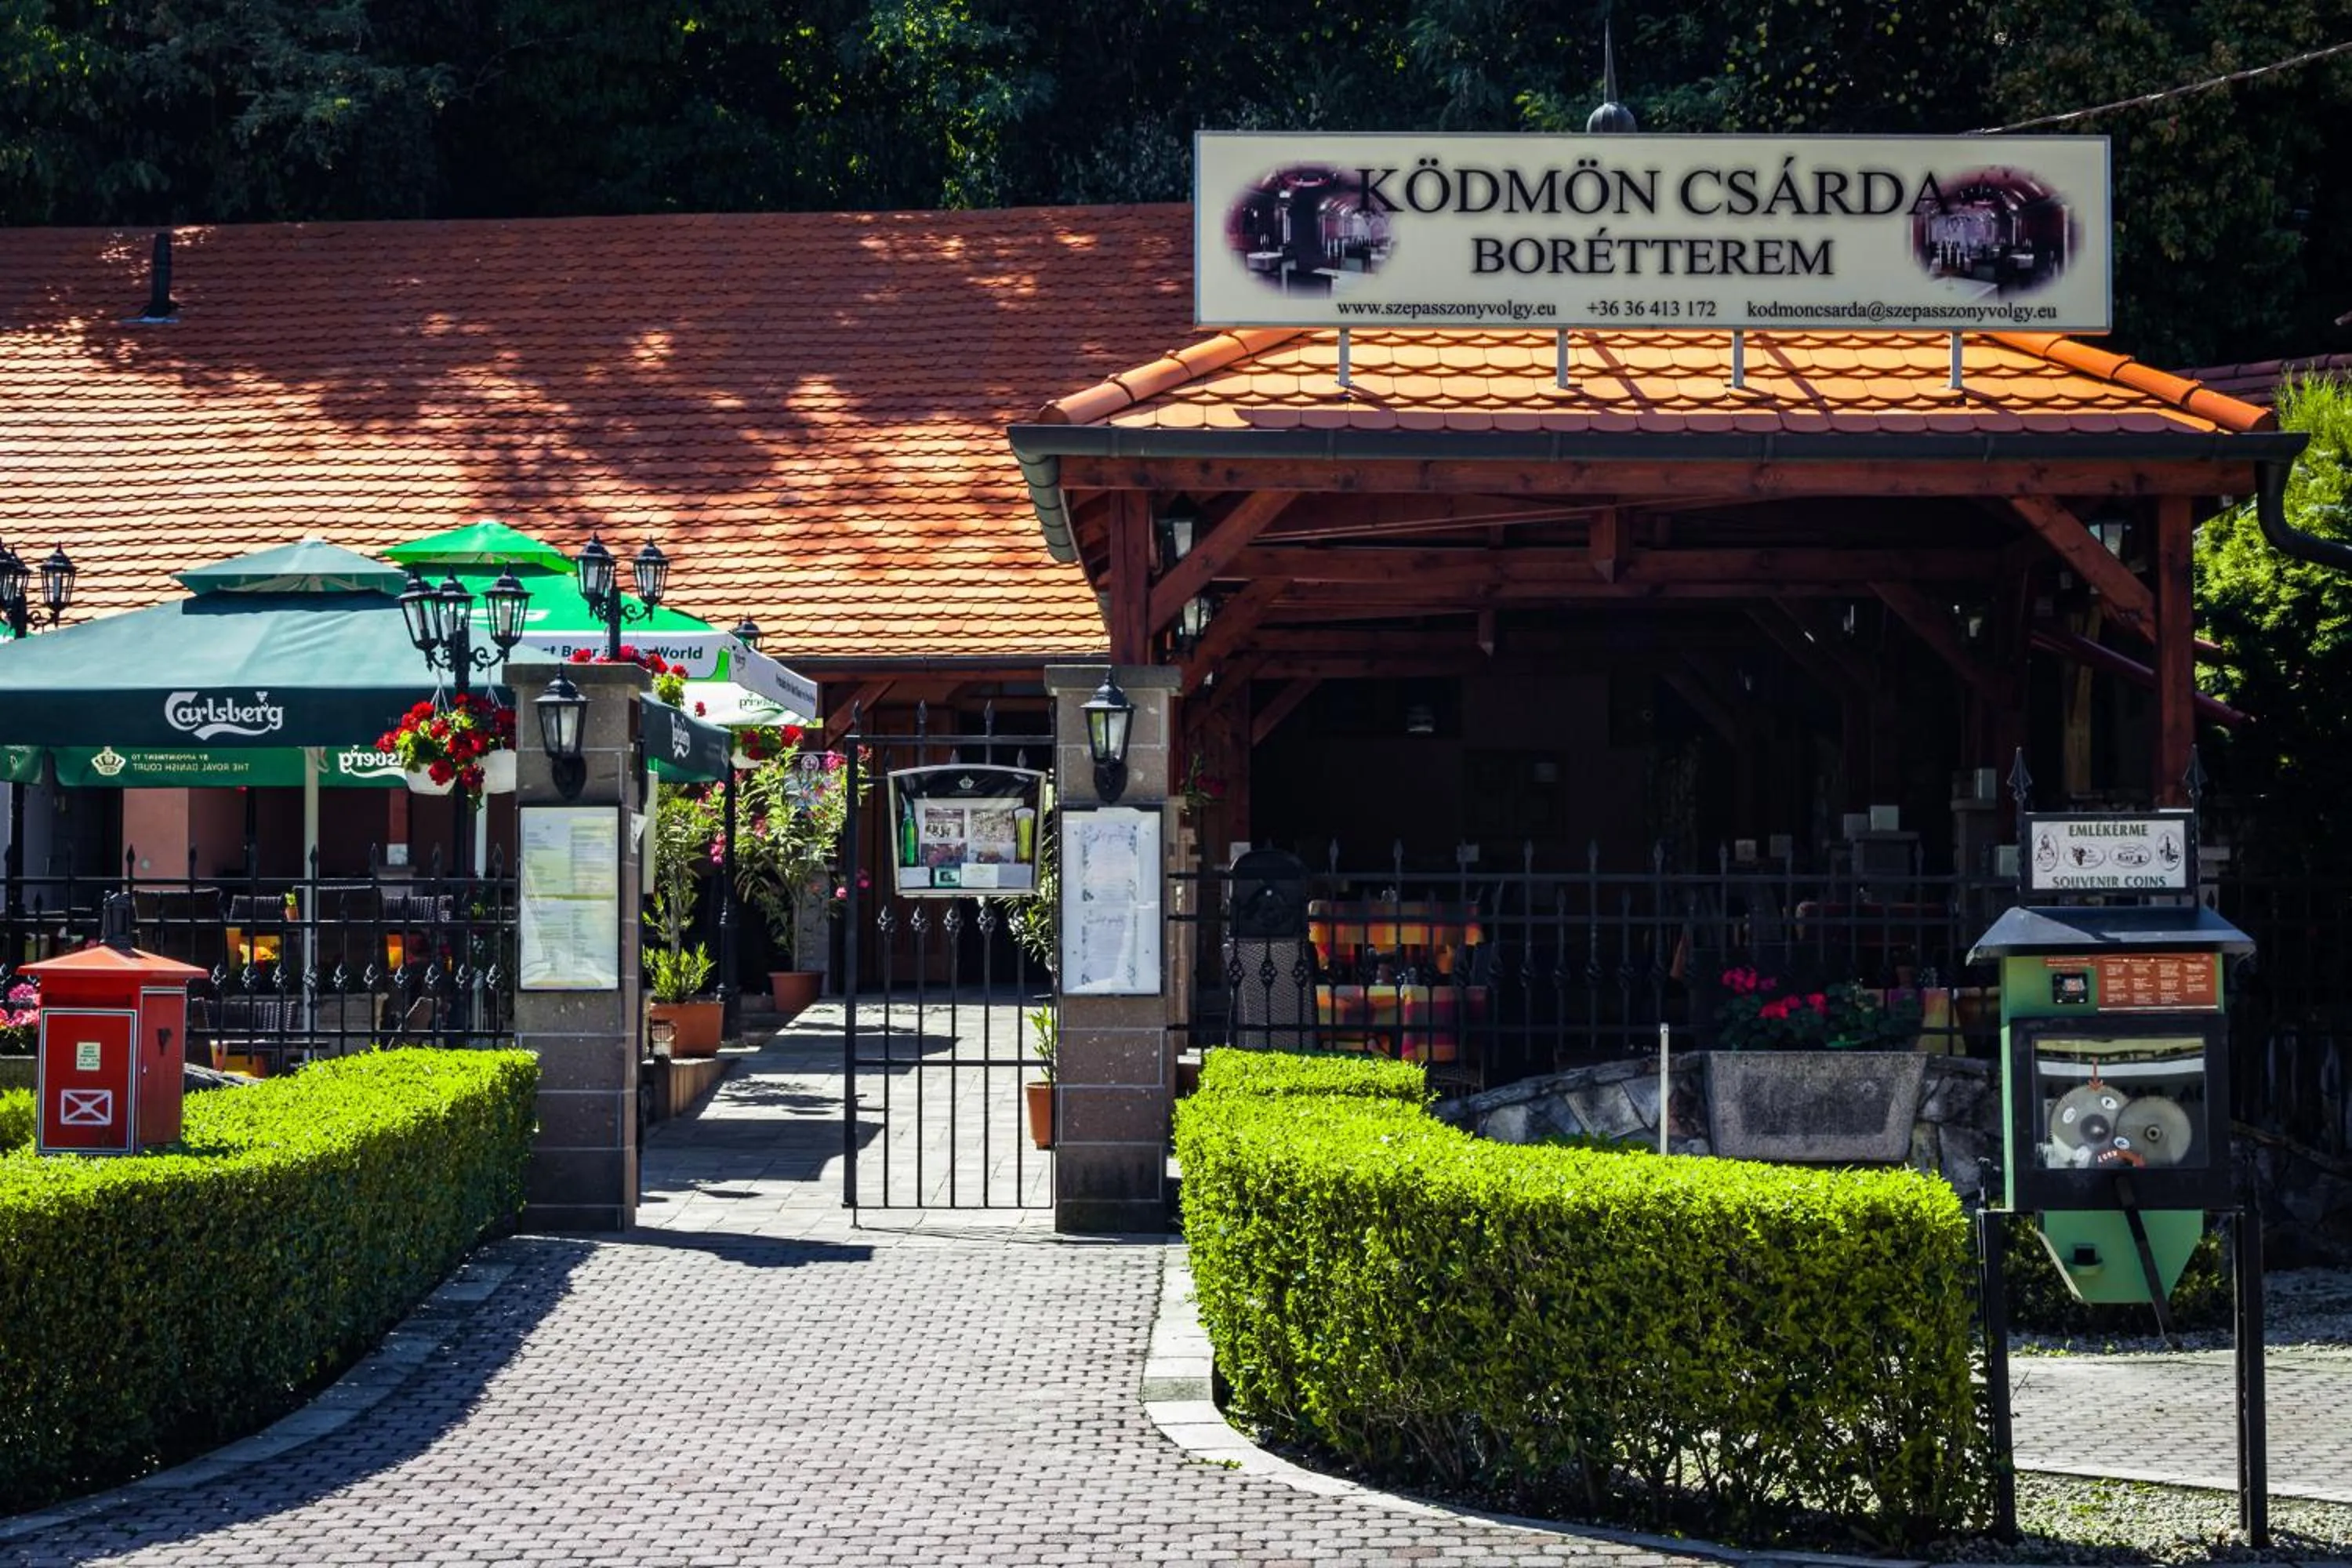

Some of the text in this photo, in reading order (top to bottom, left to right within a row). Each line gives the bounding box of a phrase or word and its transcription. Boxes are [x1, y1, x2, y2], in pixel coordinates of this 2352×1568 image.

[1355, 156, 1950, 216] KÖDMÖN CSÁRDA
[1471, 227, 1835, 275] BORÉTTEREM
[1337, 299, 1556, 319] www.szepasszonyvolgy.eu
[1587, 301, 1717, 317] +36 36 413 172
[1747, 300, 2057, 321] kodmoncsarda@szepasszonyvolgy.eu
[656, 646, 703, 659] World
[165, 691, 284, 734] Carlsberg
[2052, 876, 2166, 887] SOUVENIR COINS
